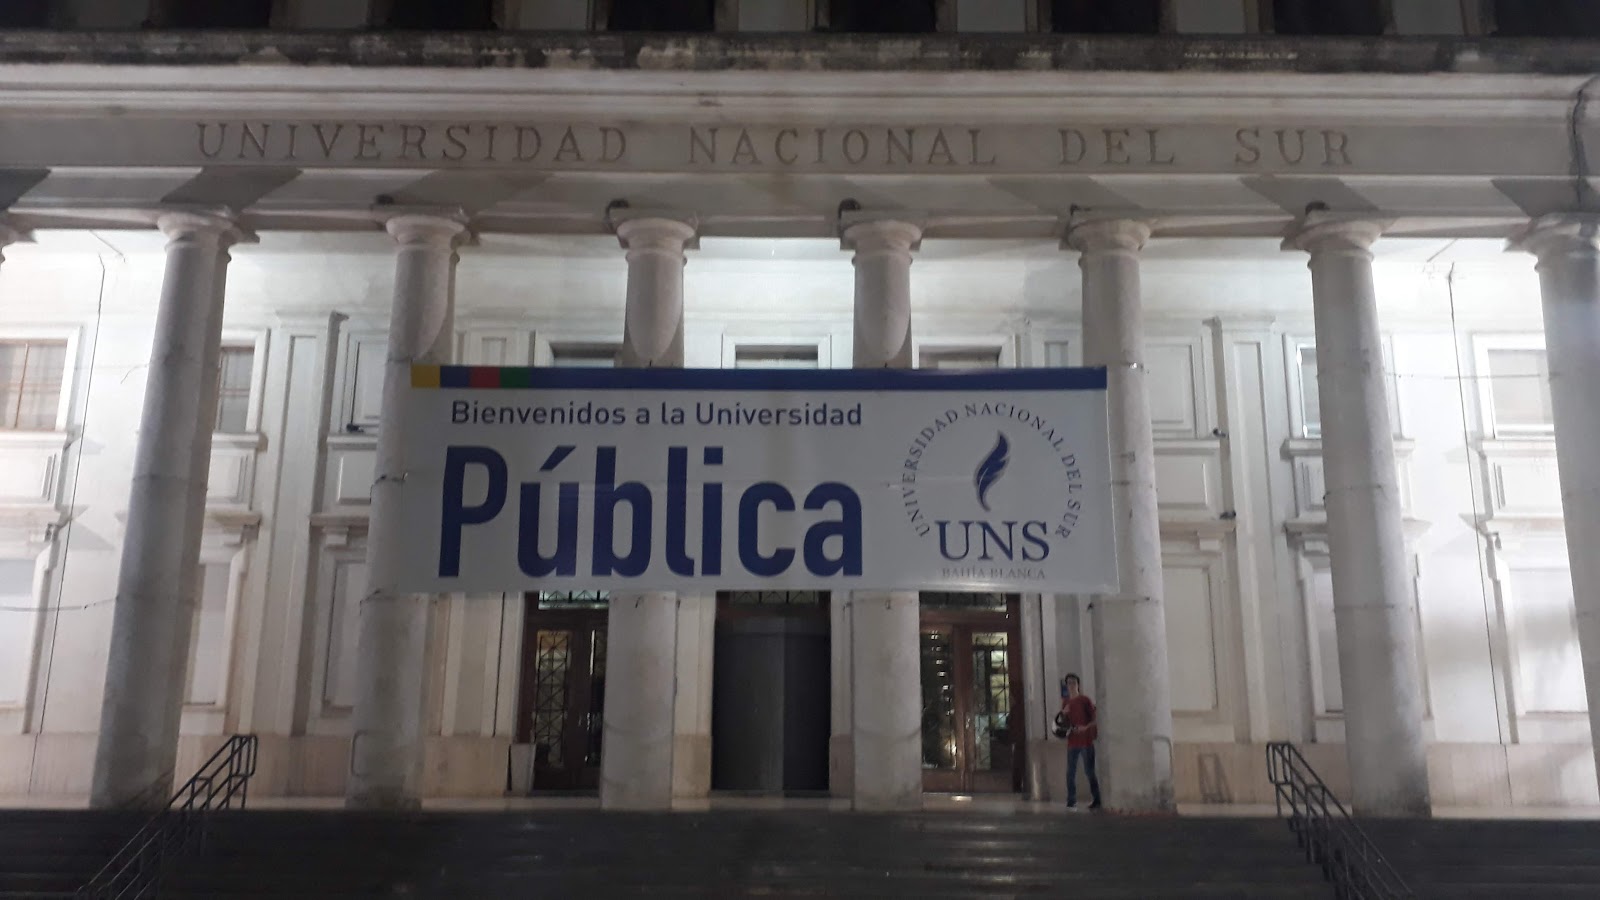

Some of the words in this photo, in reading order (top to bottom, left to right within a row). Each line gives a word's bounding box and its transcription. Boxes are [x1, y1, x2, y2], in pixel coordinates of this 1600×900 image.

[197, 122, 627, 165] UNIVERSIDAD
[688, 127, 998, 166] NACIONAL
[1058, 128, 1176, 166] DEL
[1234, 127, 1354, 166] SUR
[452, 401, 627, 425] Bienvenidos
[635, 407, 651, 425] a
[661, 402, 685, 425] la
[696, 402, 863, 426] Universidad
[964, 402, 1062, 452] NACIONAL
[902, 409, 959, 537] UNIVERSIDAD
[1061, 453, 1083, 494] DEL
[438, 445, 863, 578] Pública
[1054, 498, 1081, 539] SUR
[934, 520, 1050, 562] UNS
[990, 567, 1046, 579] BLANCA
